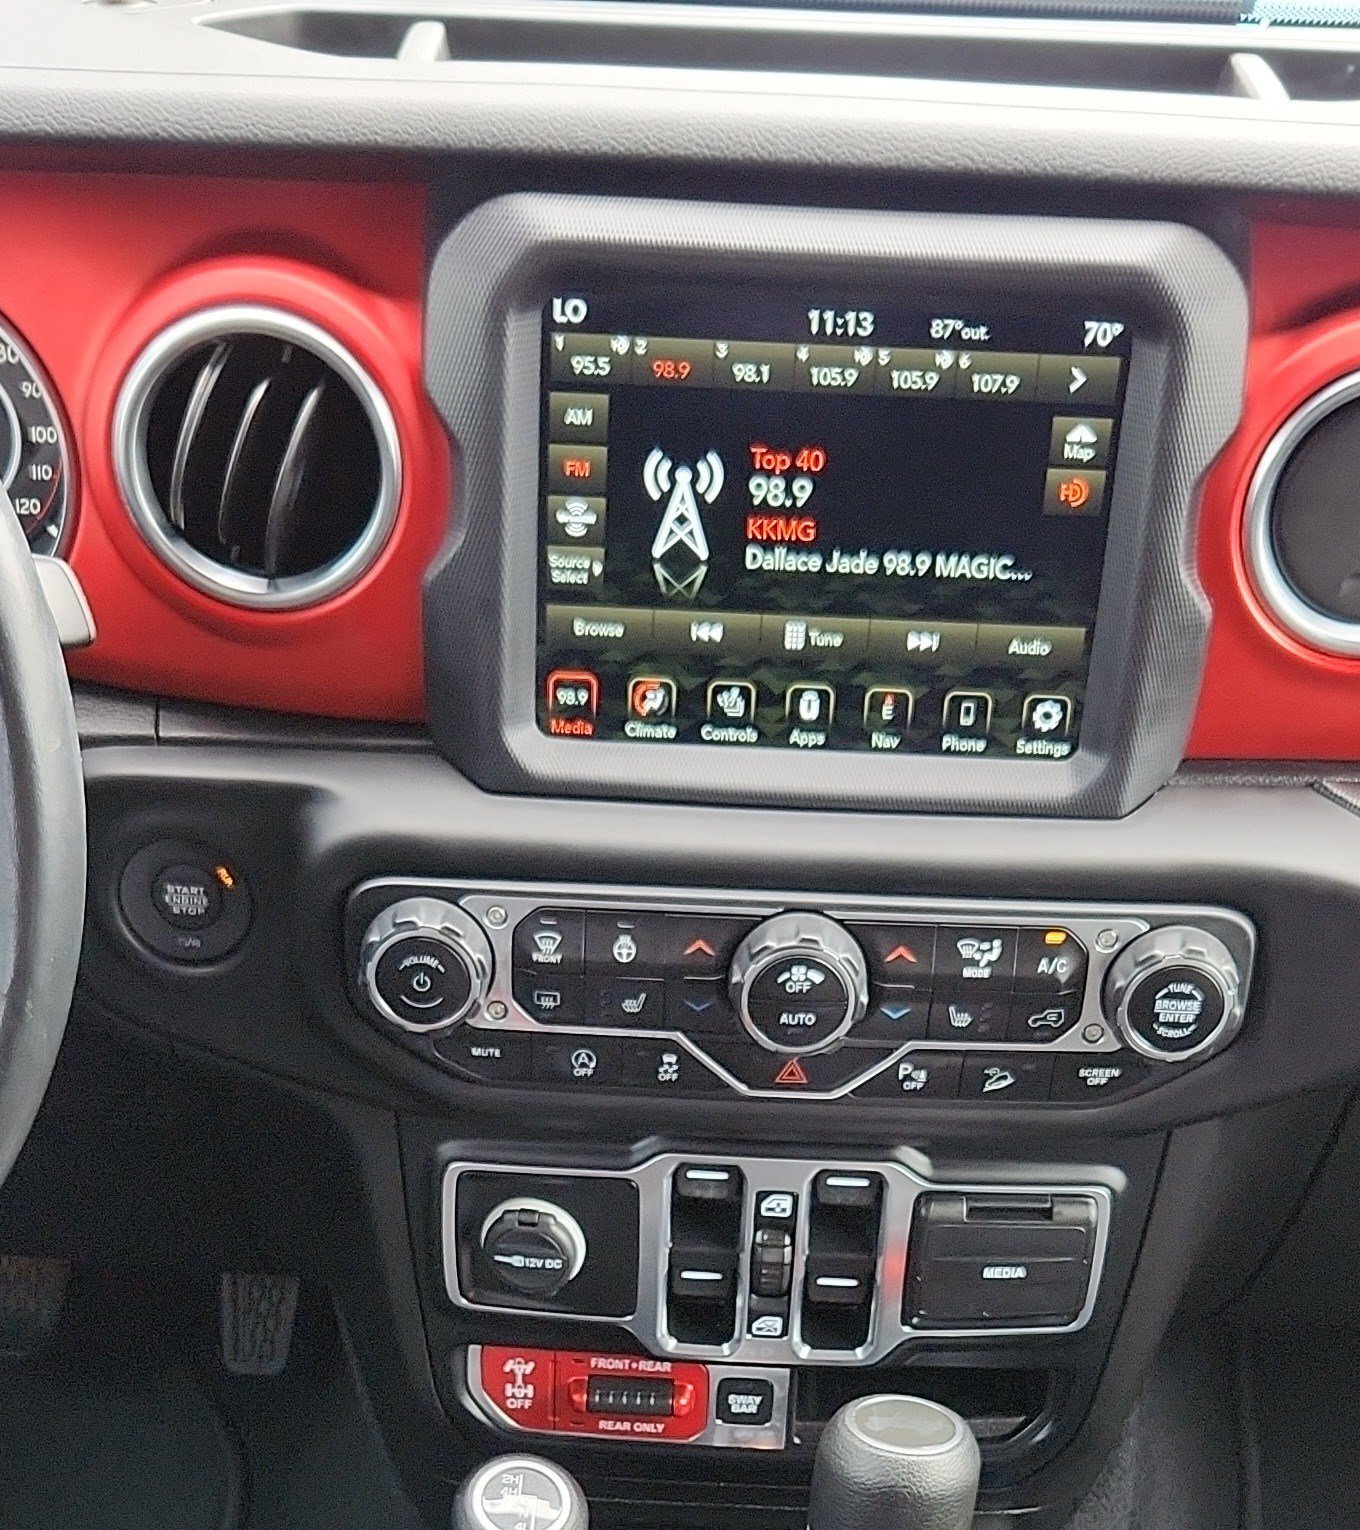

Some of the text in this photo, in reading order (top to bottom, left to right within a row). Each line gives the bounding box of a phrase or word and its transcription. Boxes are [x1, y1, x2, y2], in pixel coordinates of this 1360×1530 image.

[552, 297, 588, 324] LO
[807, 308, 875, 336] 11:13
[634, 336, 648, 356] 2
[715, 340, 729, 359] 3
[570, 355, 611, 376] 95.5
[652, 360, 691, 379] 98.9
[732, 362, 771, 384] 98.1
[810, 366, 859, 388] 105.9
[890, 369, 940, 391] 105.9
[971, 373, 1021, 395] 107.9
[21, 381, 41, 399] 90
[564, 408, 594, 426] AM
[29, 426, 57, 444] 100
[750, 447, 825, 475] Top 40
[1063, 444, 1095, 463] Map
[30, 464, 53, 481] 110
[564, 461, 591, 478] FM
[749, 476, 813, 508] 98.9
[15, 498, 41, 514] 120
[747, 517, 816, 541] KKMG
[549, 555, 590, 569] Source
[745, 544, 822, 572] Dallace
[826, 547, 879, 575] Jade
[883, 550, 932, 577] 98.9
[551, 569, 588, 585] Select
[572, 617, 625, 638] Browse
[808, 631, 844, 648] Tune
[1008, 636, 1052, 656] Audio
[551, 720, 592, 735] Media
[624, 721, 677, 740] Climate
[700, 724, 758, 743] Controls
[790, 728, 825, 747] Apps
[872, 731, 901, 750] Nav
[942, 733, 987, 753] Phone
[1016, 738, 1071, 758] Settings
[403, 955, 438, 968] VOLUME
[532, 953, 562, 964] FRONT
[1037, 957, 1067, 974] A/C
[962, 966, 991, 978] MODE
[785, 982, 812, 994] OFF
[1168, 982, 1194, 995] TUNE
[1154, 999, 1202, 1011] BROWSE
[779, 1012, 816, 1026] AUTO
[1159, 1013, 1195, 1023] ENTER
[1156, 1027, 1192, 1038] SCROLL
[471, 1047, 501, 1058] MUTE
[573, 1068, 594, 1077] OFF
[657, 1072, 679, 1082] OFF
[1078, 1067, 1120, 1078] SCREEN
[903, 1082, 924, 1091] OFF
[1087, 1077, 1108, 1086] OFF
[525, 1257, 563, 1270] 12V DC
[982, 1266, 1027, 1279] MEDIA
[506, 1398, 532, 1409] OFF
[728, 1394, 762, 1405] SWAY
[731, 1403, 758, 1414] BAR
[598, 1420, 665, 1434] REAR ONLY
[502, 1474, 519, 1485] 2H
[500, 1487, 518, 1496] 4H
